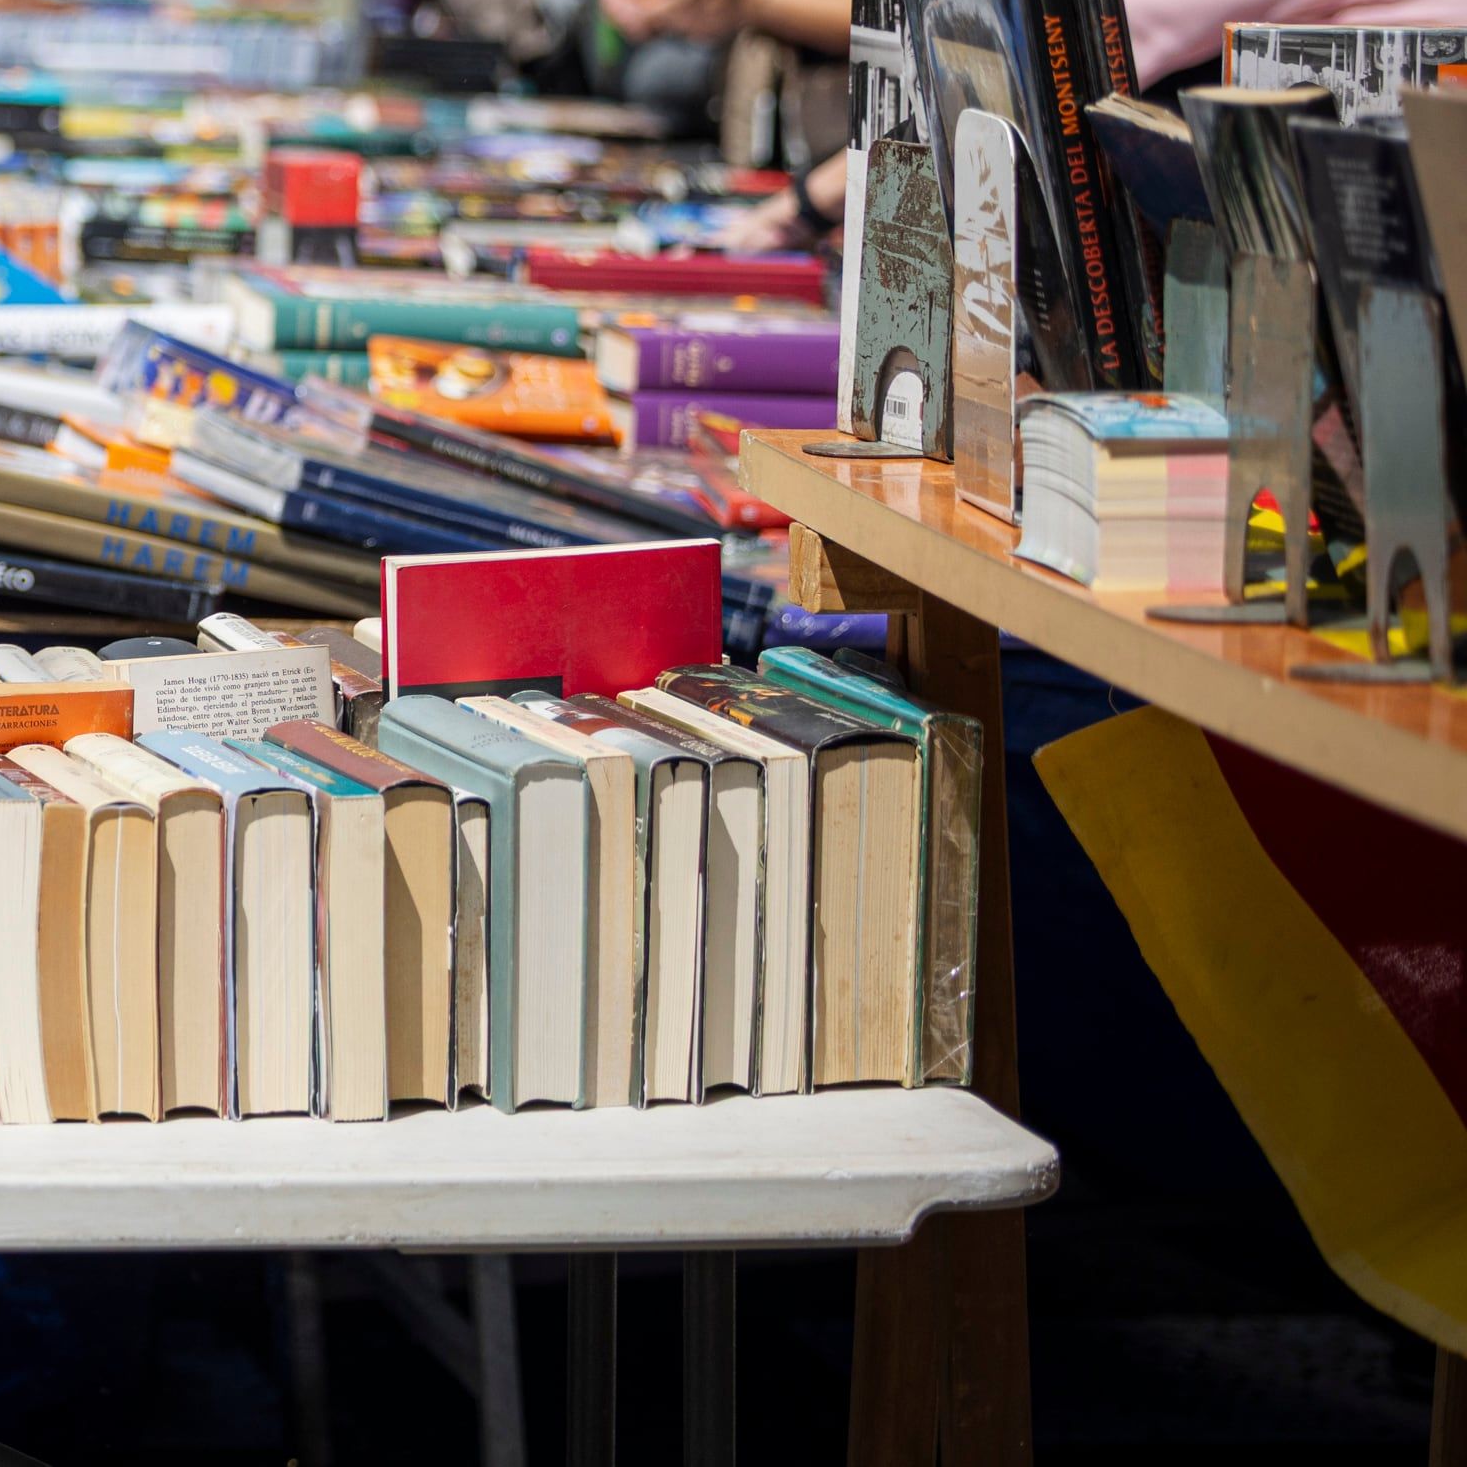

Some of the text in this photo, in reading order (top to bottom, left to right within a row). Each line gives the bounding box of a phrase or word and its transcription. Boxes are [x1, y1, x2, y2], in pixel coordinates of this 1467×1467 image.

[1101, 14, 1129, 96] NTSENY
[1043, 14, 1119, 371] LA DESCOBERTA DEL MONTSENY
[107, 499, 257, 555] HAREM
[101, 535, 251, 587] HAREM
[163, 678, 184, 686] James
[188, 677, 207, 685] Hogg
[210, 672, 249, 683] (1770-1835)
[251, 670, 269, 679] nació
[282, 668, 301, 676] Etrick
[304, 667, 315, 675] (Es-
[156, 687, 177, 696] cocia)
[180, 685, 201, 694] donde
[204, 684, 220, 692] vivió
[244, 681, 270, 690] granjero
[156, 697, 175, 705] lapso
[193, 694, 217, 702] tiempo
[221, 693, 233, 701] que
[292, 685, 307, 694] pasó
[157, 704, 199, 714] Edimburgo,
[203, 701, 238, 711] ejerciendo
[241, 699, 248, 707] el
[251, 697, 286, 708] periodismo
[296, 694, 317, 702] relacio-
[251, 707, 270, 716] Byron
[211, 721, 223, 729] por
[227, 718, 249, 726] Walter
[252, 716, 270, 724] Scott,
[281, 714, 299, 723] quien
